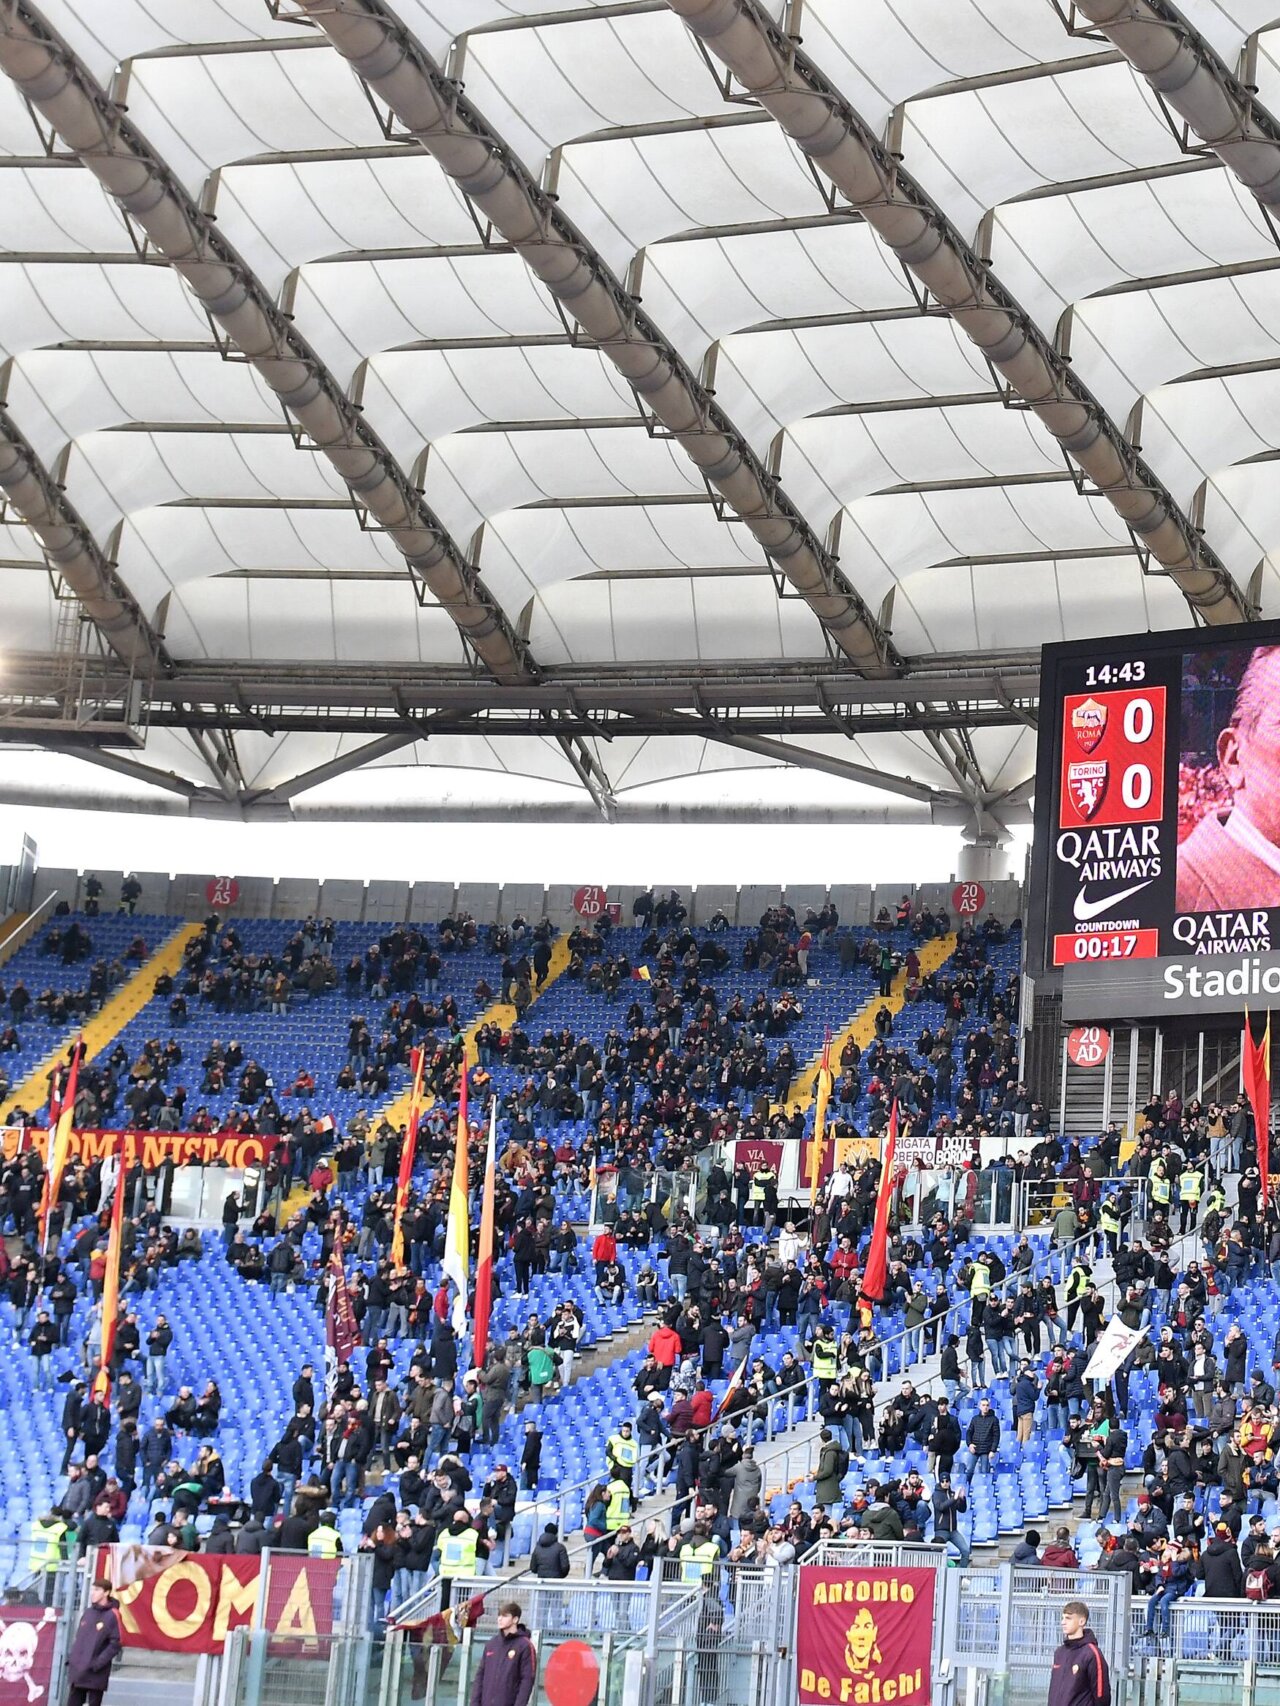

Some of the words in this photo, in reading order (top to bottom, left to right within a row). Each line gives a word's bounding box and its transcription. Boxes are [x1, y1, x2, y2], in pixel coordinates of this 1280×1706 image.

[1085, 661, 1146, 686] 14:43
[1123, 698, 1153, 744] 0
[1077, 730, 1101, 739] ROMA
[1073, 766, 1104, 776] TORINO
[1092, 778, 1104, 787] FC
[1121, 763, 1152, 809] 0
[1056, 825, 1161, 868] QATAR
[1079, 857, 1162, 882] AIRWAYS
[215, 877, 231, 890] 21
[211, 891, 231, 904] AS
[583, 887, 599, 900] 21
[962, 885, 978, 898] 20
[580, 900, 601, 914] AD
[960, 899, 978, 912] AS
[1075, 920, 1140, 932] COUNTDOWN
[1172, 911, 1271, 945] QATAR
[1074, 935, 1137, 959] 00:17
[1195, 936, 1271, 955] AIRWAYS
[1079, 1026, 1100, 1043] 20
[1076, 1044, 1103, 1062] AD
[894, 1138, 931, 1150] RIGATA
[747, 1149, 766, 1161] VIA
[893, 1151, 934, 1163] OBERTO
[936, 1150, 978, 1165] BARON
[813, 1578, 915, 1606] Antonio
[800, 1668, 831, 1698] De
[839, 1668, 922, 1704] Falchi
